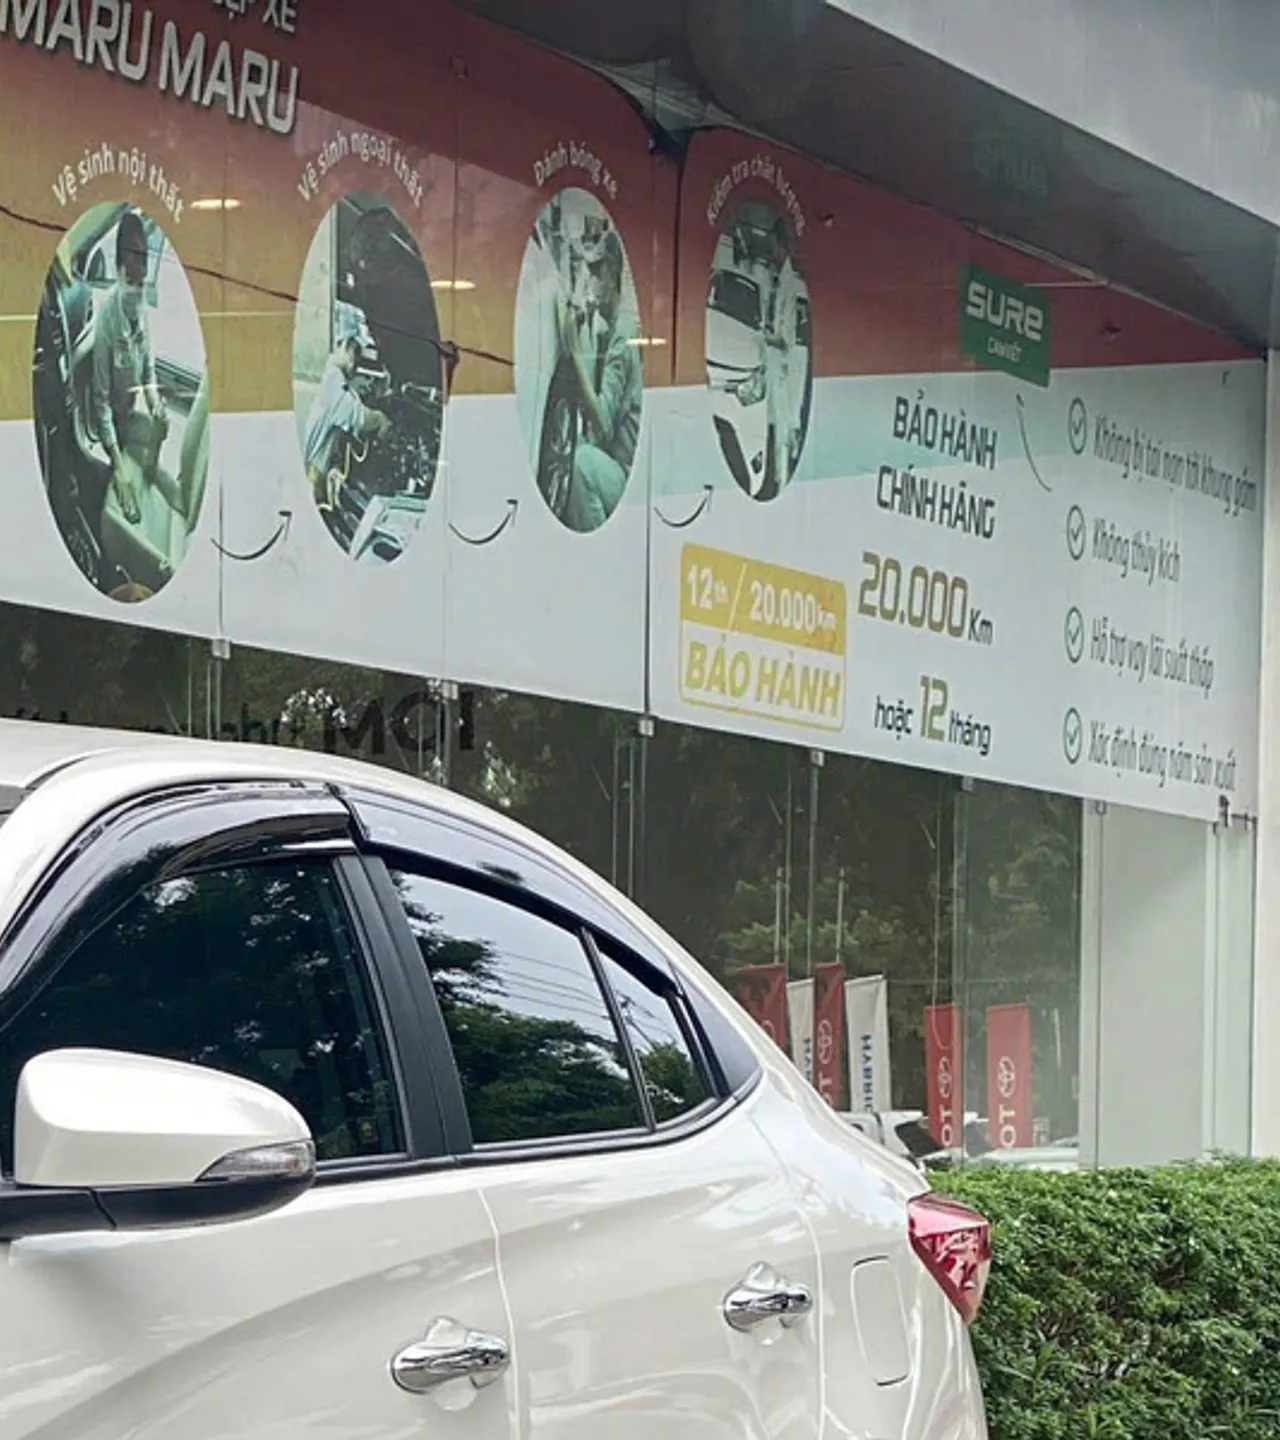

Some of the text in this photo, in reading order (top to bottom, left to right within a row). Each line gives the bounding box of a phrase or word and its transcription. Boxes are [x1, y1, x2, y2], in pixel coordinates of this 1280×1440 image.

[157, 20, 299, 134] MARU
[51, 164, 77, 207] Vệ
[77, 141, 116, 185] sinh
[118, 147, 146, 186] nội
[297, 161, 319, 202] Vệ
[317, 130, 349, 175] sinh
[351, 131, 393, 167] ngoại
[602, 167, 619, 201] xe
[966, 280, 1044, 342] SURE
[893, 388, 998, 470] BẢO HÀNH
[876, 463, 996, 539] CHÍNH HÃNG
[684, 634, 840, 717] BẢO HÀNH
[873, 674, 991, 756] hoặc 12 tháng
